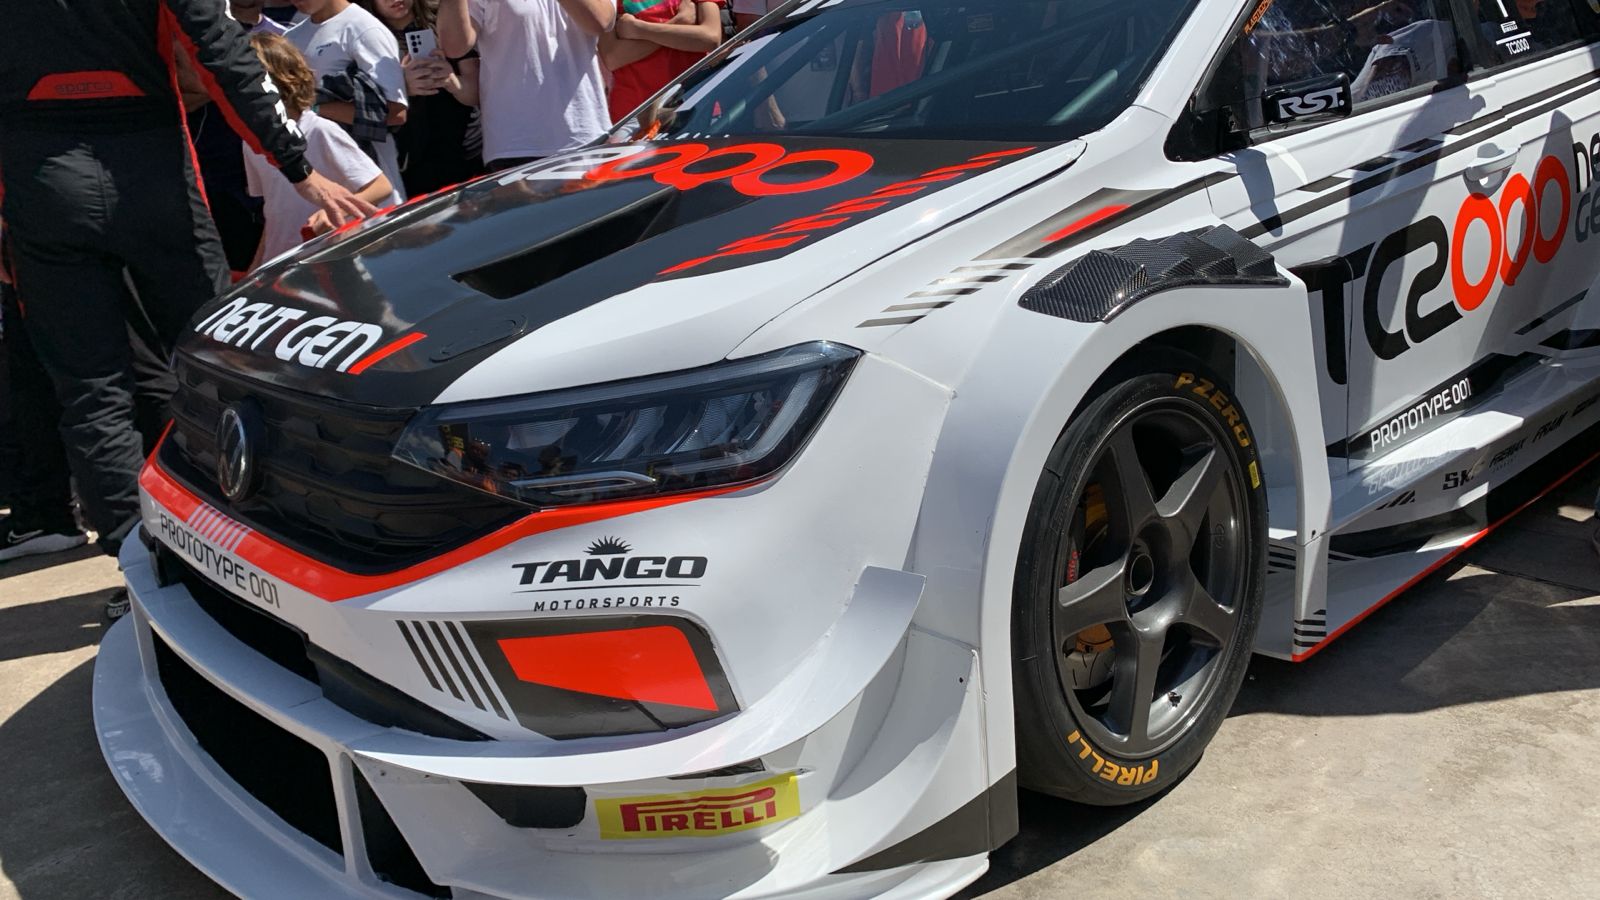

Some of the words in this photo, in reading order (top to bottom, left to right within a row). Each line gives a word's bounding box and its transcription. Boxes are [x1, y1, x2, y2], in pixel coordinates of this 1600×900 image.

[1289, 155, 1571, 385] TC2000
[1370, 394, 1452, 453] PROTOTYPE
[1452, 377, 1472, 405] 001
[159, 513, 247, 590] PROTOTYPE
[249, 574, 281, 609] 001
[511, 556, 708, 585] TANGO
[533, 595, 681, 612] MOTORSPORTS
[1067, 730, 1159, 785] PIRELLI
[618, 787, 777, 832] PIRELLI
